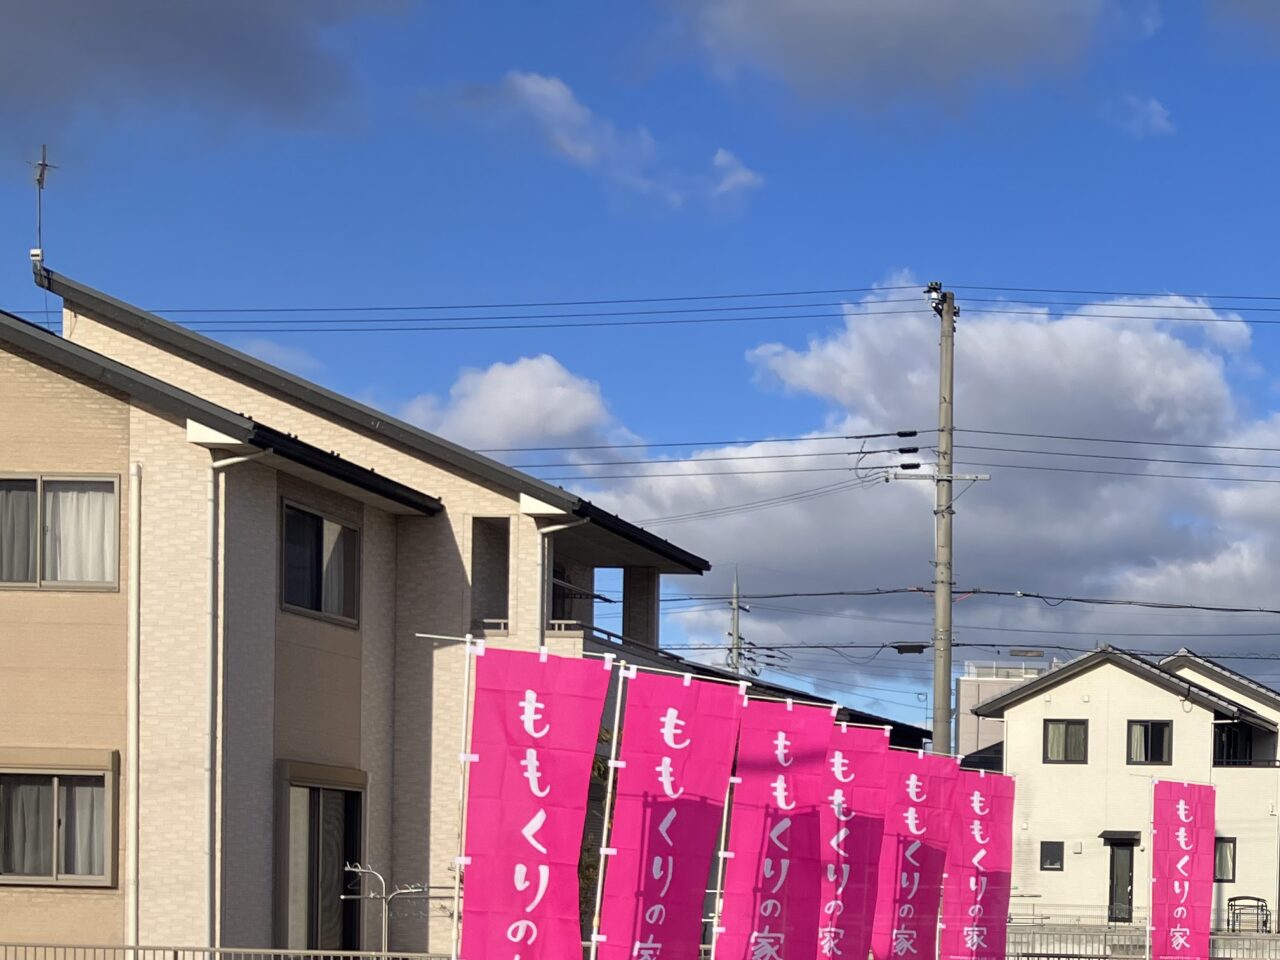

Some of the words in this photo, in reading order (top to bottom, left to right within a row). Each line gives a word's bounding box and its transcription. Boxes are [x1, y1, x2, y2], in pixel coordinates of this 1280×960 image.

[818, 750, 856, 955] ももくりの家
[892, 773, 927, 955] ももくりの家
[963, 790, 990, 951] ももくりの家
[1170, 799, 1193, 950] ももくりの家
